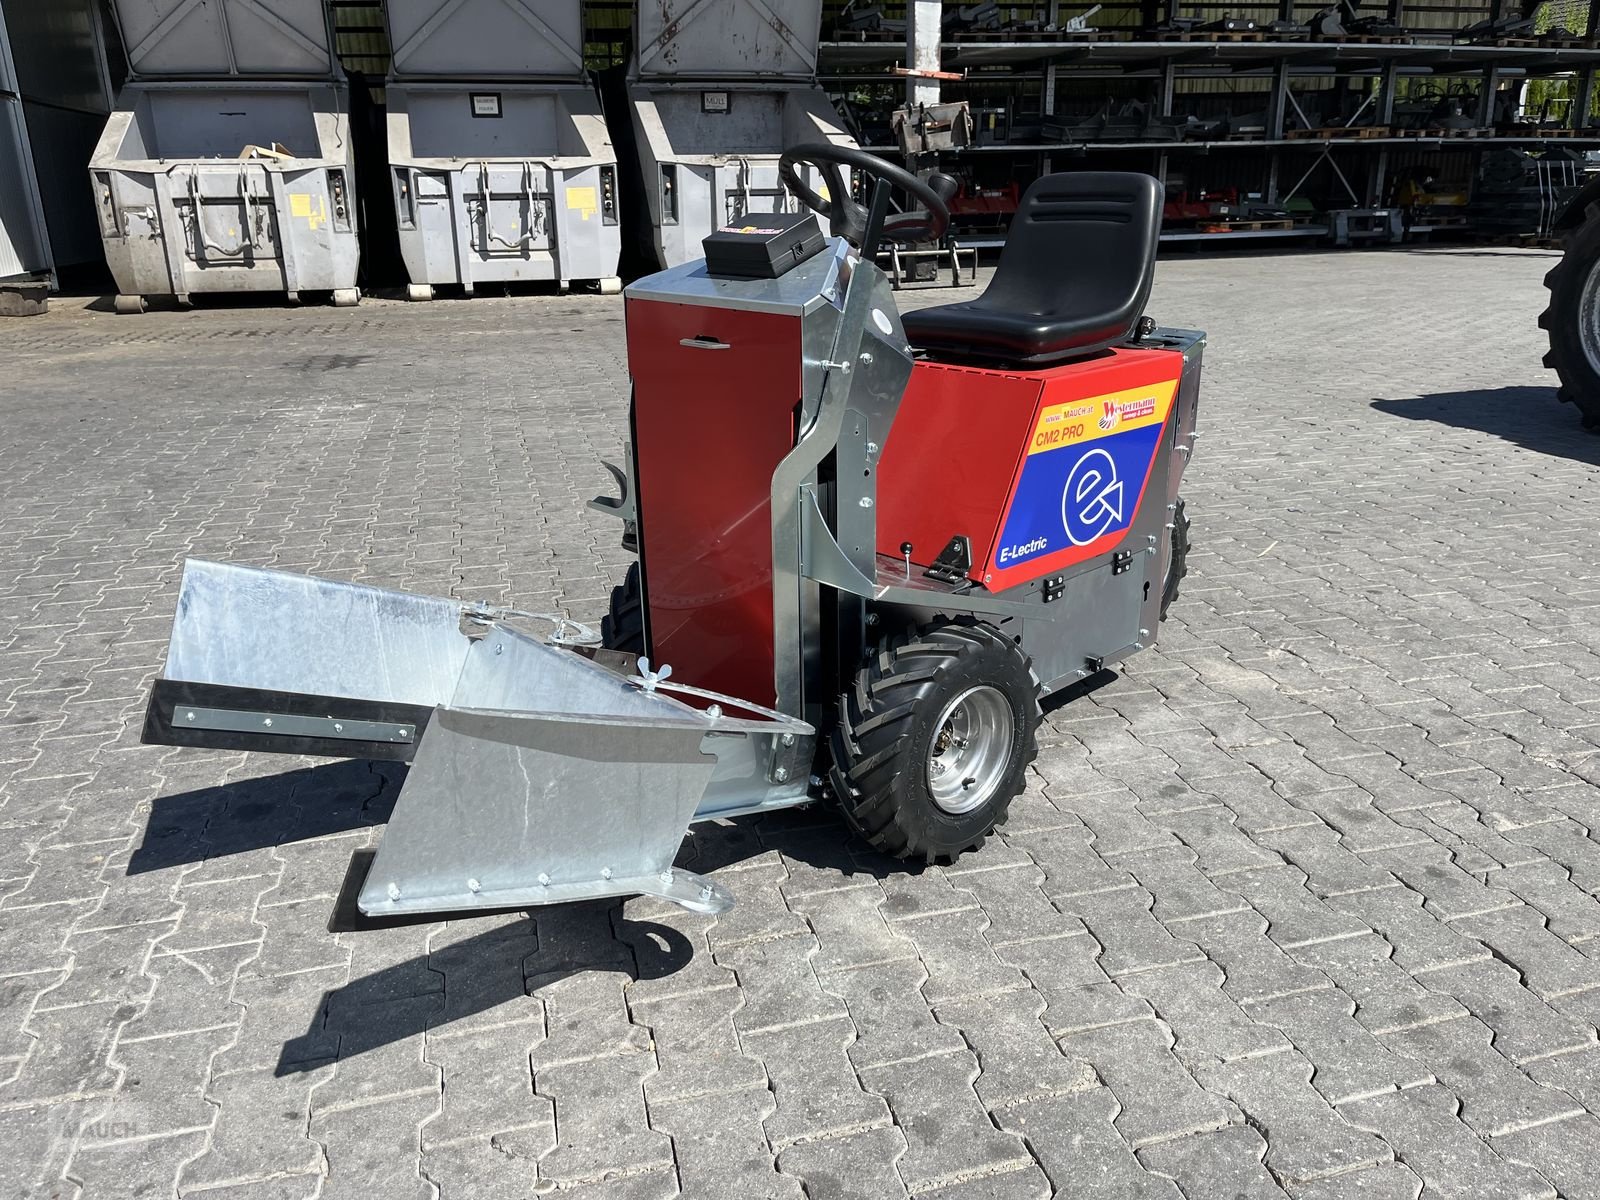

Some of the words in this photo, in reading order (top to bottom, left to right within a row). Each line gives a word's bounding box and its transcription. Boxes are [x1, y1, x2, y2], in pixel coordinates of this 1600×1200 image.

[1103, 398, 1155, 418] Westermann
[1036, 429, 1059, 447] CM2
[1061, 423, 1084, 441] PRO
[1000, 536, 1047, 562] E-Lectric
